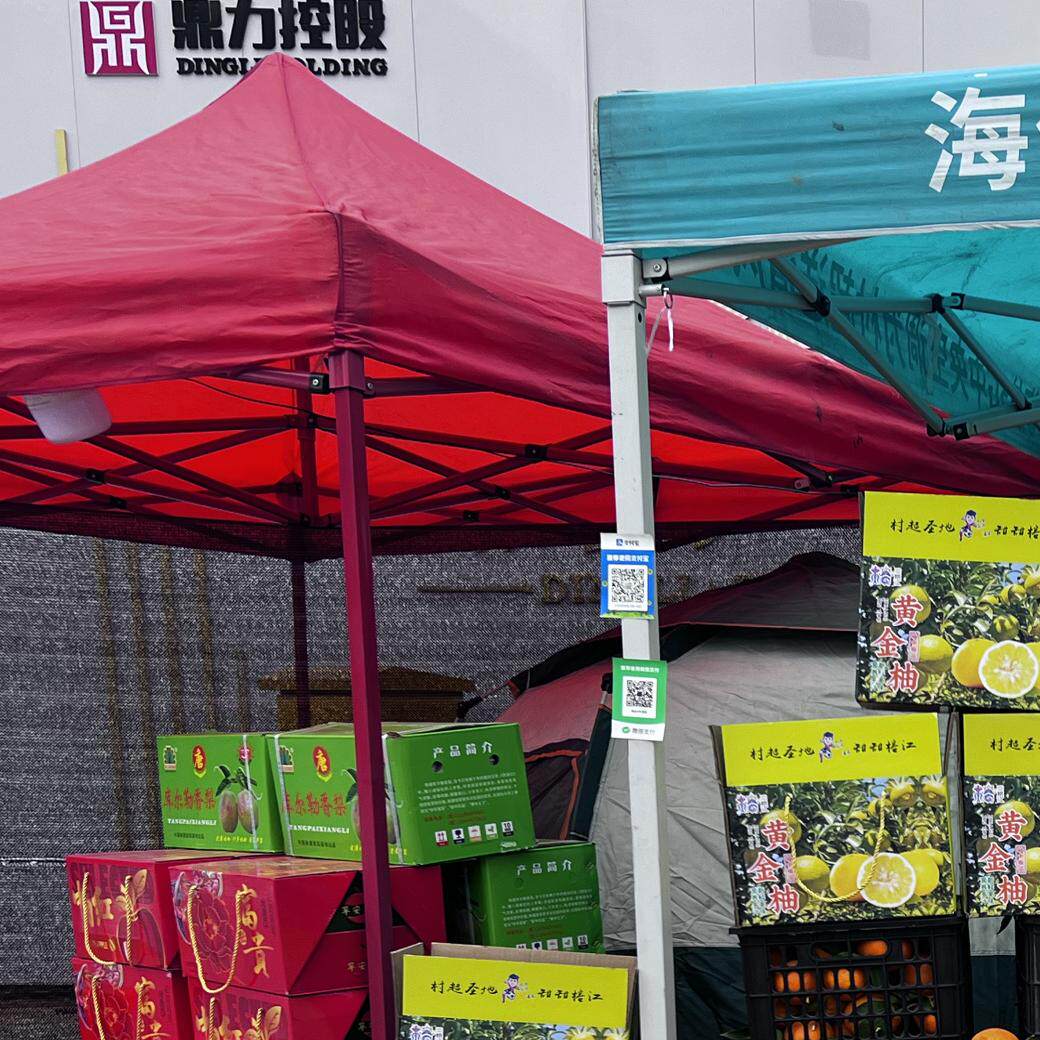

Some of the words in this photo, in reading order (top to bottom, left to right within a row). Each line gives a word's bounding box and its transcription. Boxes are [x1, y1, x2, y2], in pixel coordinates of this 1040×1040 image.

[172, 0, 387, 50] 鼎力控股
[176, 57, 263, 76] DINGL
[871, 594, 924, 693] 黄金柚
[747, 819, 800, 914] 黄金柚
[979, 809, 1029, 905] 黄金柚
